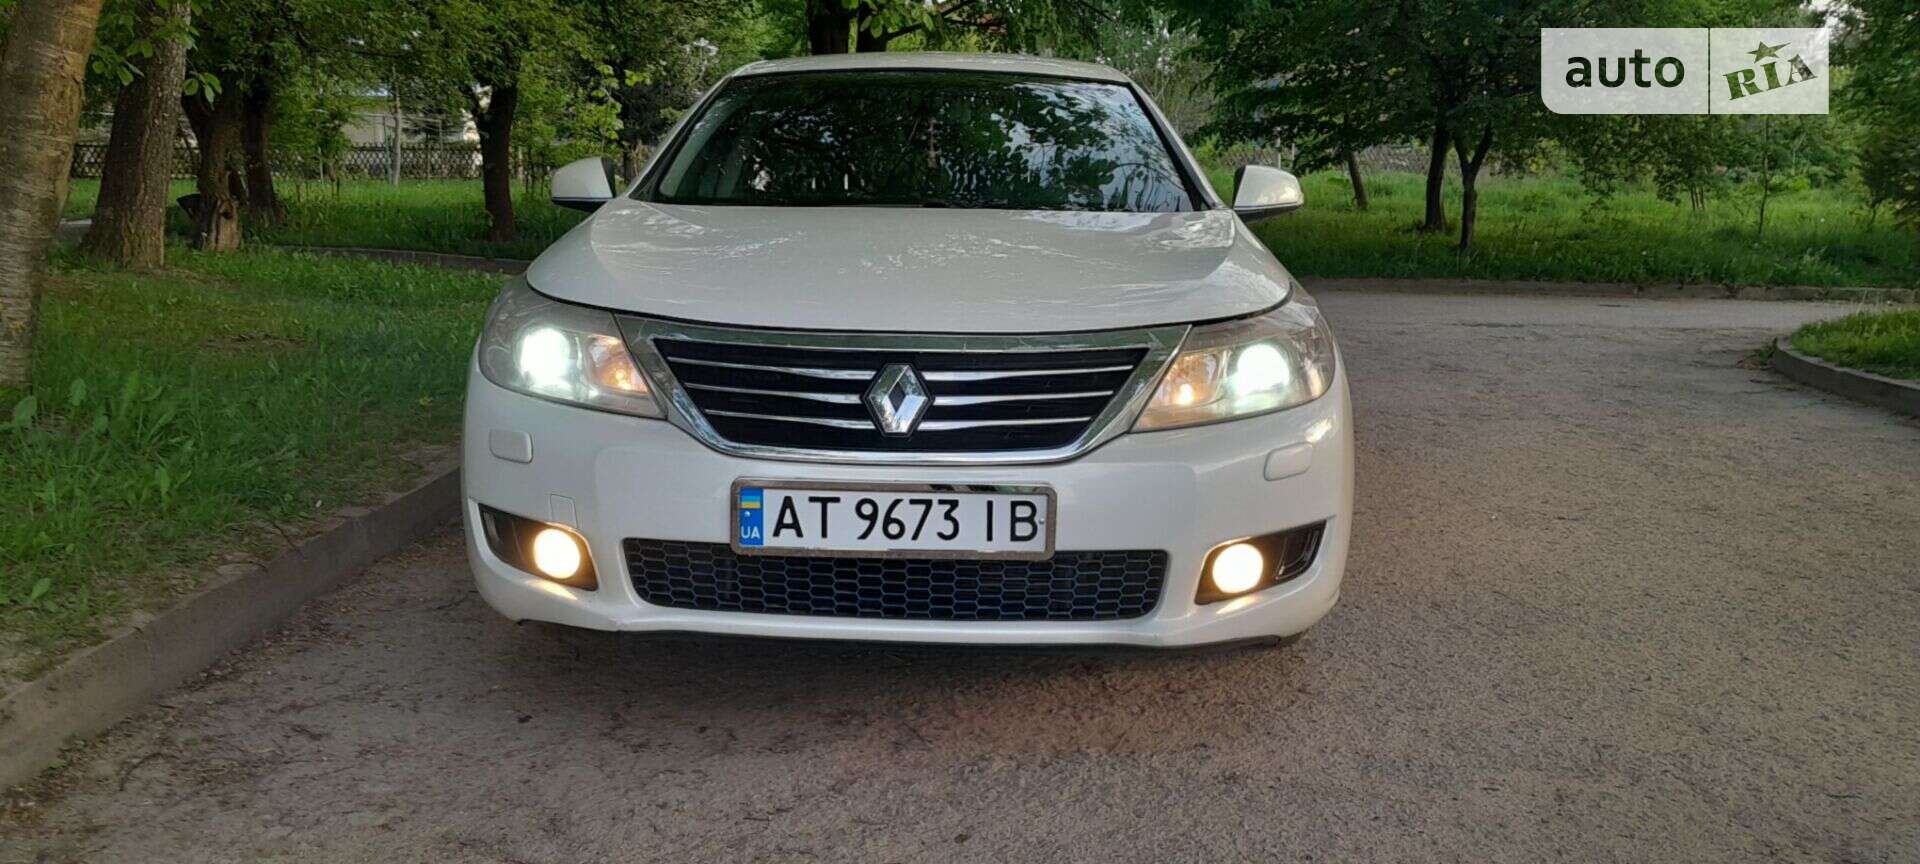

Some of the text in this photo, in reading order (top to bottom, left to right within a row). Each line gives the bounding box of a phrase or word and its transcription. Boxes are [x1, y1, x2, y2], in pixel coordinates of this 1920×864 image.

[740, 526, 761, 539] UA
[772, 495, 1038, 542] AT 9673 IB
